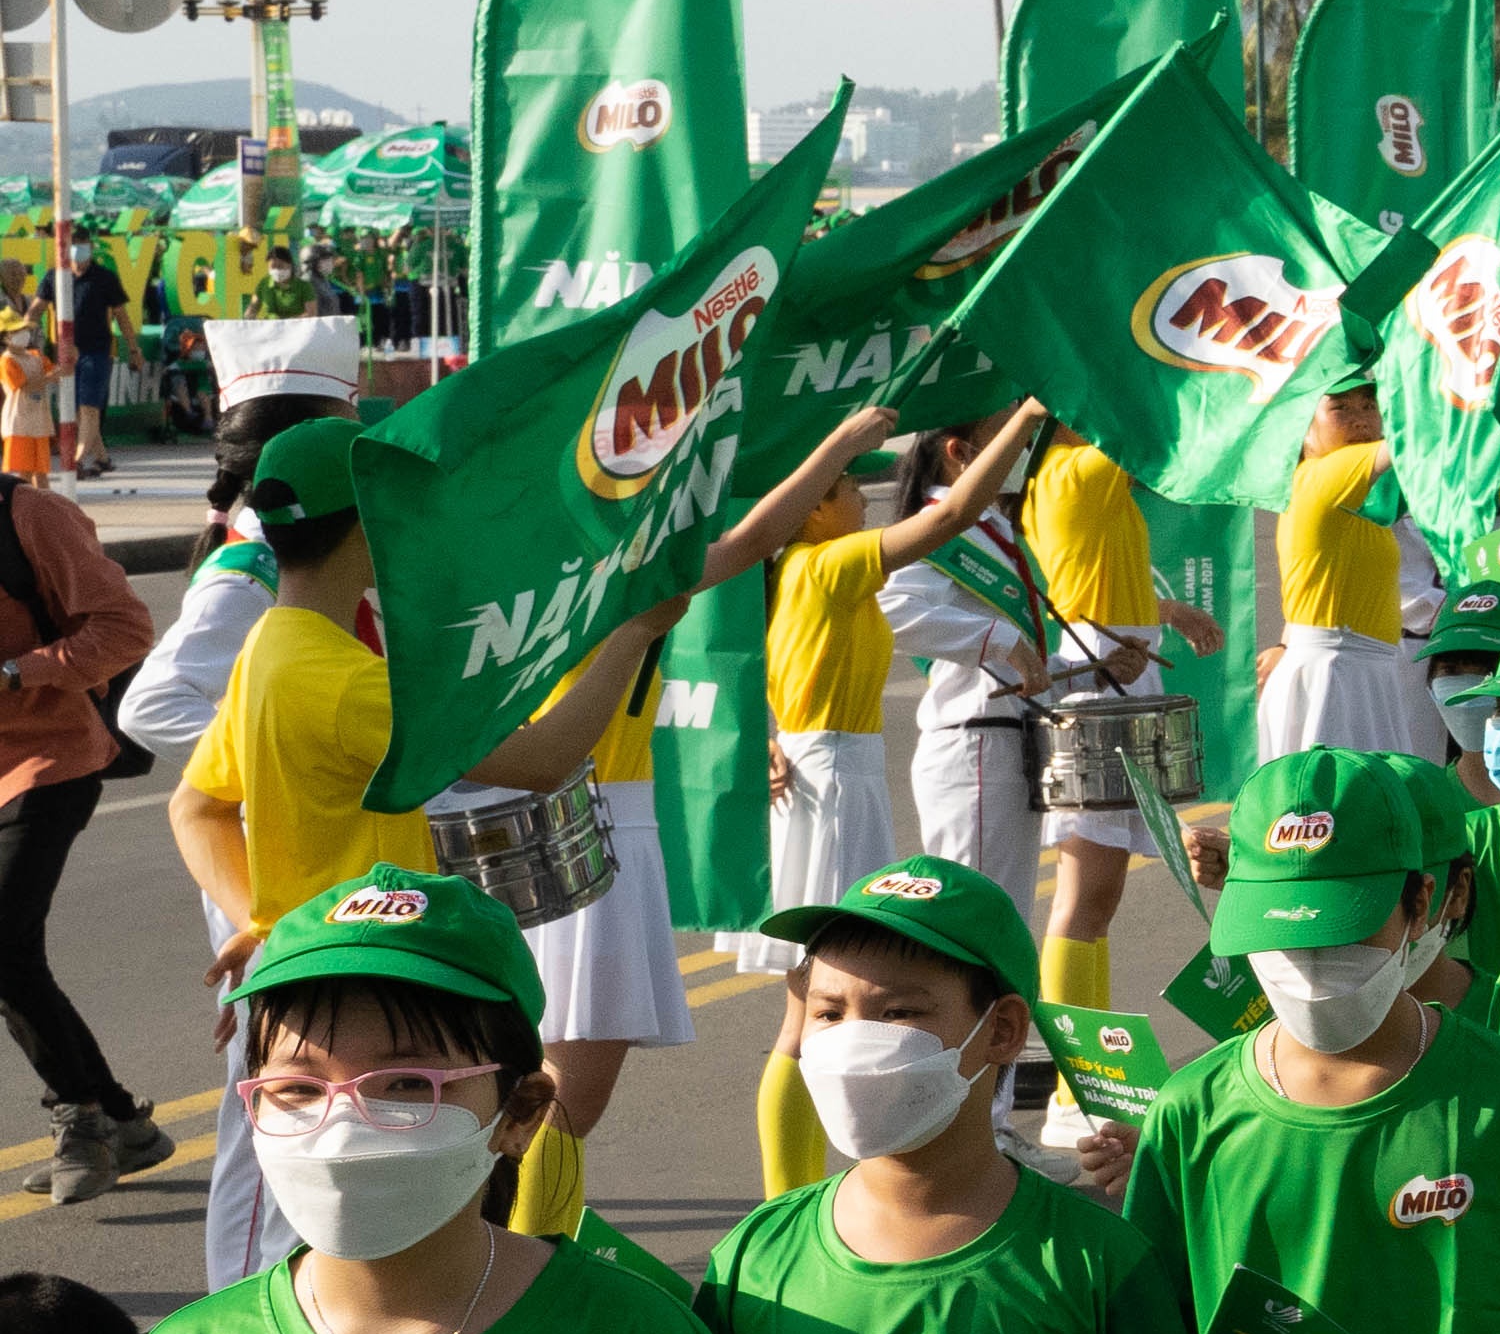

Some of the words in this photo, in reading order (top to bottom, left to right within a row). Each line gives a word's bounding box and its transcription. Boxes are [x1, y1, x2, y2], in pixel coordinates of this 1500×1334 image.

[594, 97, 661, 133] MILO
[1393, 103, 1416, 165] MILO
[613, 296, 767, 459] MILO
[1274, 822, 1327, 845] MILO
[877, 877, 932, 897] MILO
[343, 898, 419, 919] MILO
[1401, 1186, 1467, 1215] MILO
